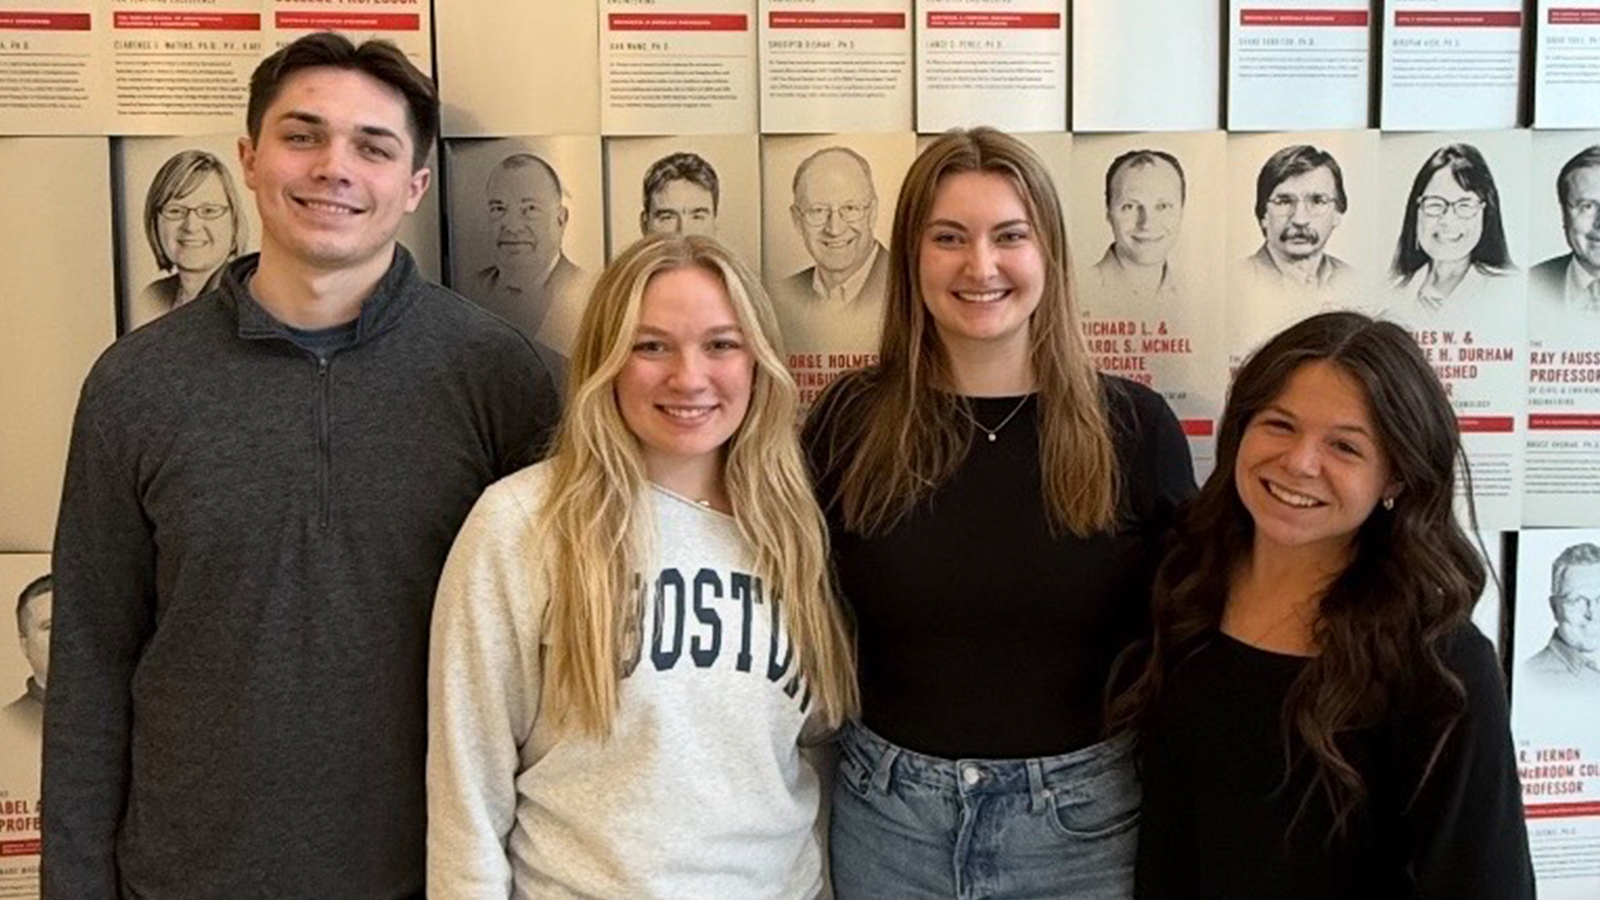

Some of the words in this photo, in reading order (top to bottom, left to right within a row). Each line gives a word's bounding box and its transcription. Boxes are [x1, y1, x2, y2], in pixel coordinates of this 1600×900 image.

[1158, 322, 1168, 335] &
[1463, 331, 1474, 344] &
[829, 354, 880, 369] HOLMES
[1459, 348, 1513, 362] DURHAM
[1530, 352, 1556, 365] RAY
[1536, 748, 1580, 762] VERNON
